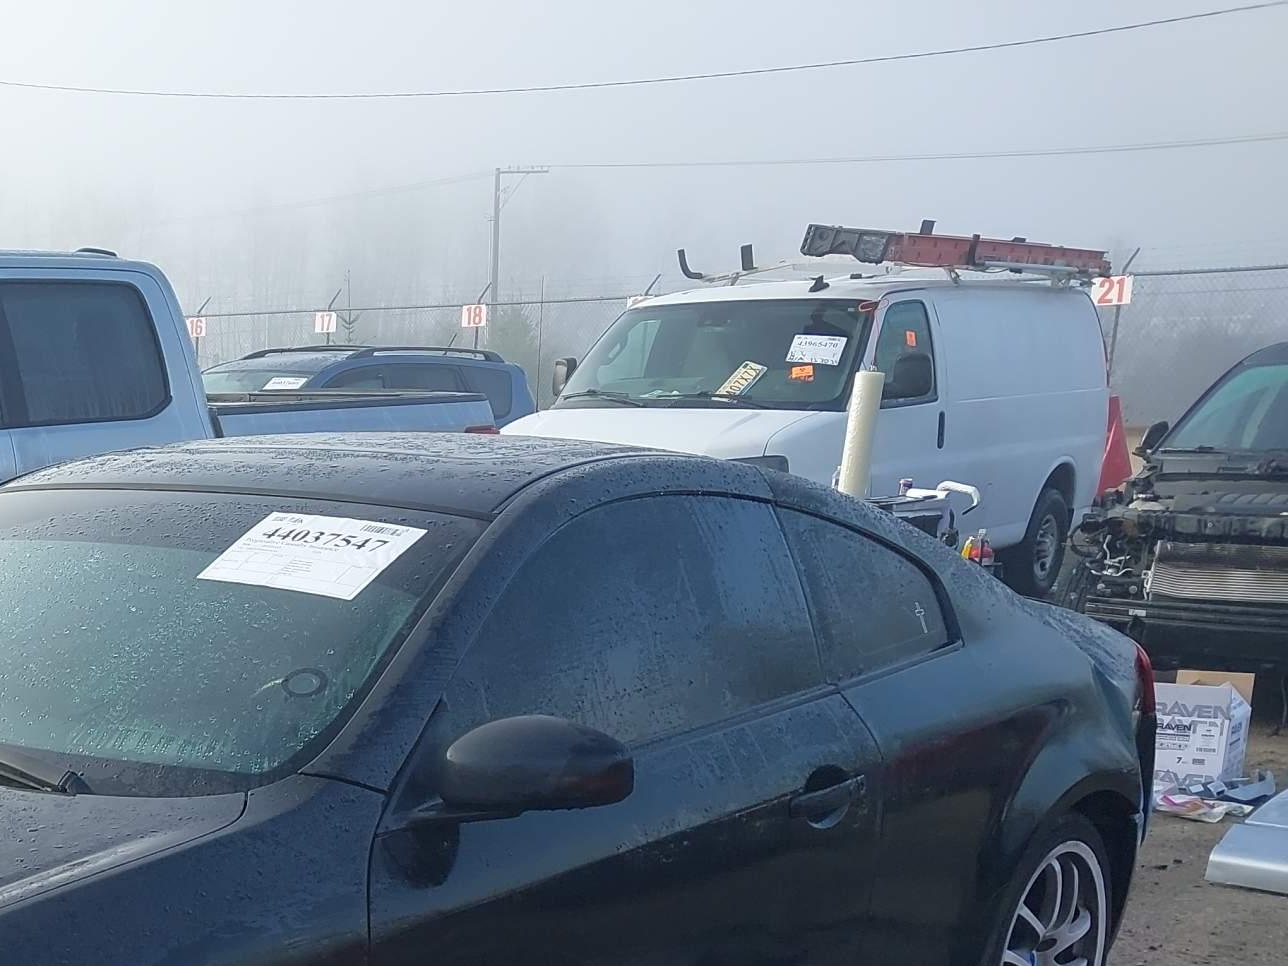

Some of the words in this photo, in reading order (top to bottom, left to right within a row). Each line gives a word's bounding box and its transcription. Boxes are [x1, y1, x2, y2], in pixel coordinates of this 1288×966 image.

[1097, 277, 1126, 305] 21
[320, 313, 333, 332] 17
[466, 305, 483, 326] 18
[189, 318, 203, 337] 16
[262, 526, 390, 552] 44037547
[1176, 756, 1183, 764] 7
